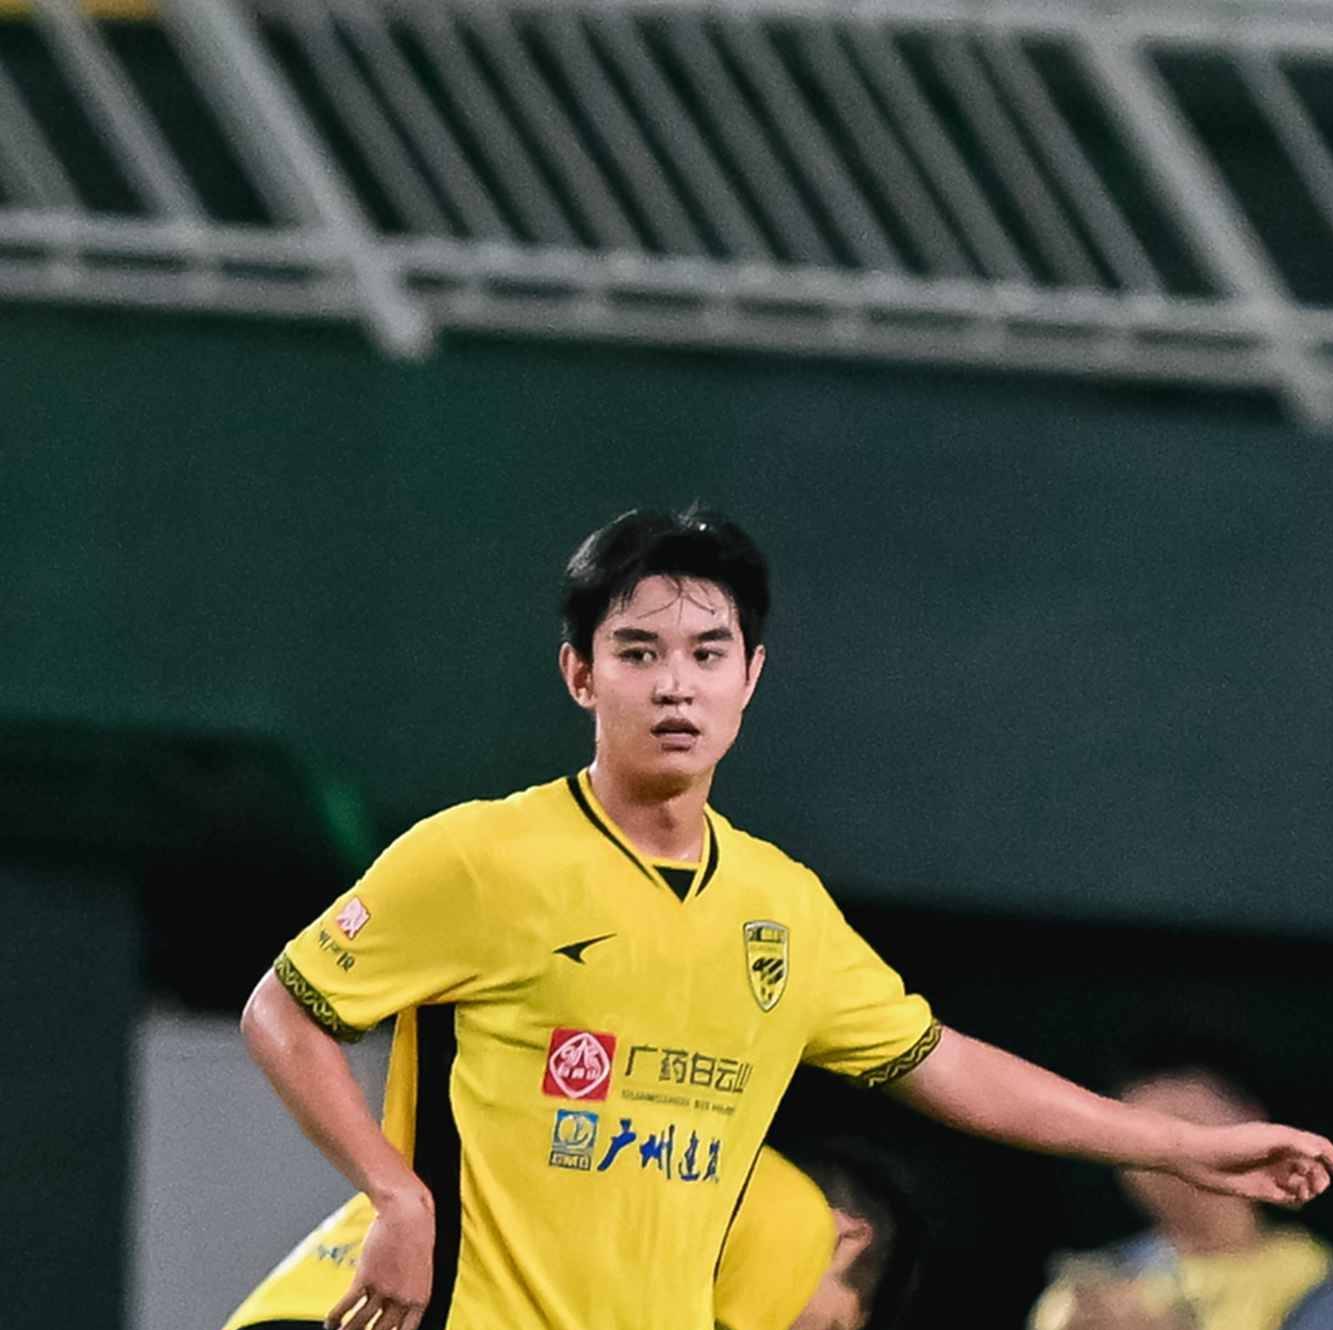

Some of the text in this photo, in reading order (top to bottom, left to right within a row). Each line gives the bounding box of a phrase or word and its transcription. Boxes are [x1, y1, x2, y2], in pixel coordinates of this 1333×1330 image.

[624, 1044, 752, 1094] 广药白云山
